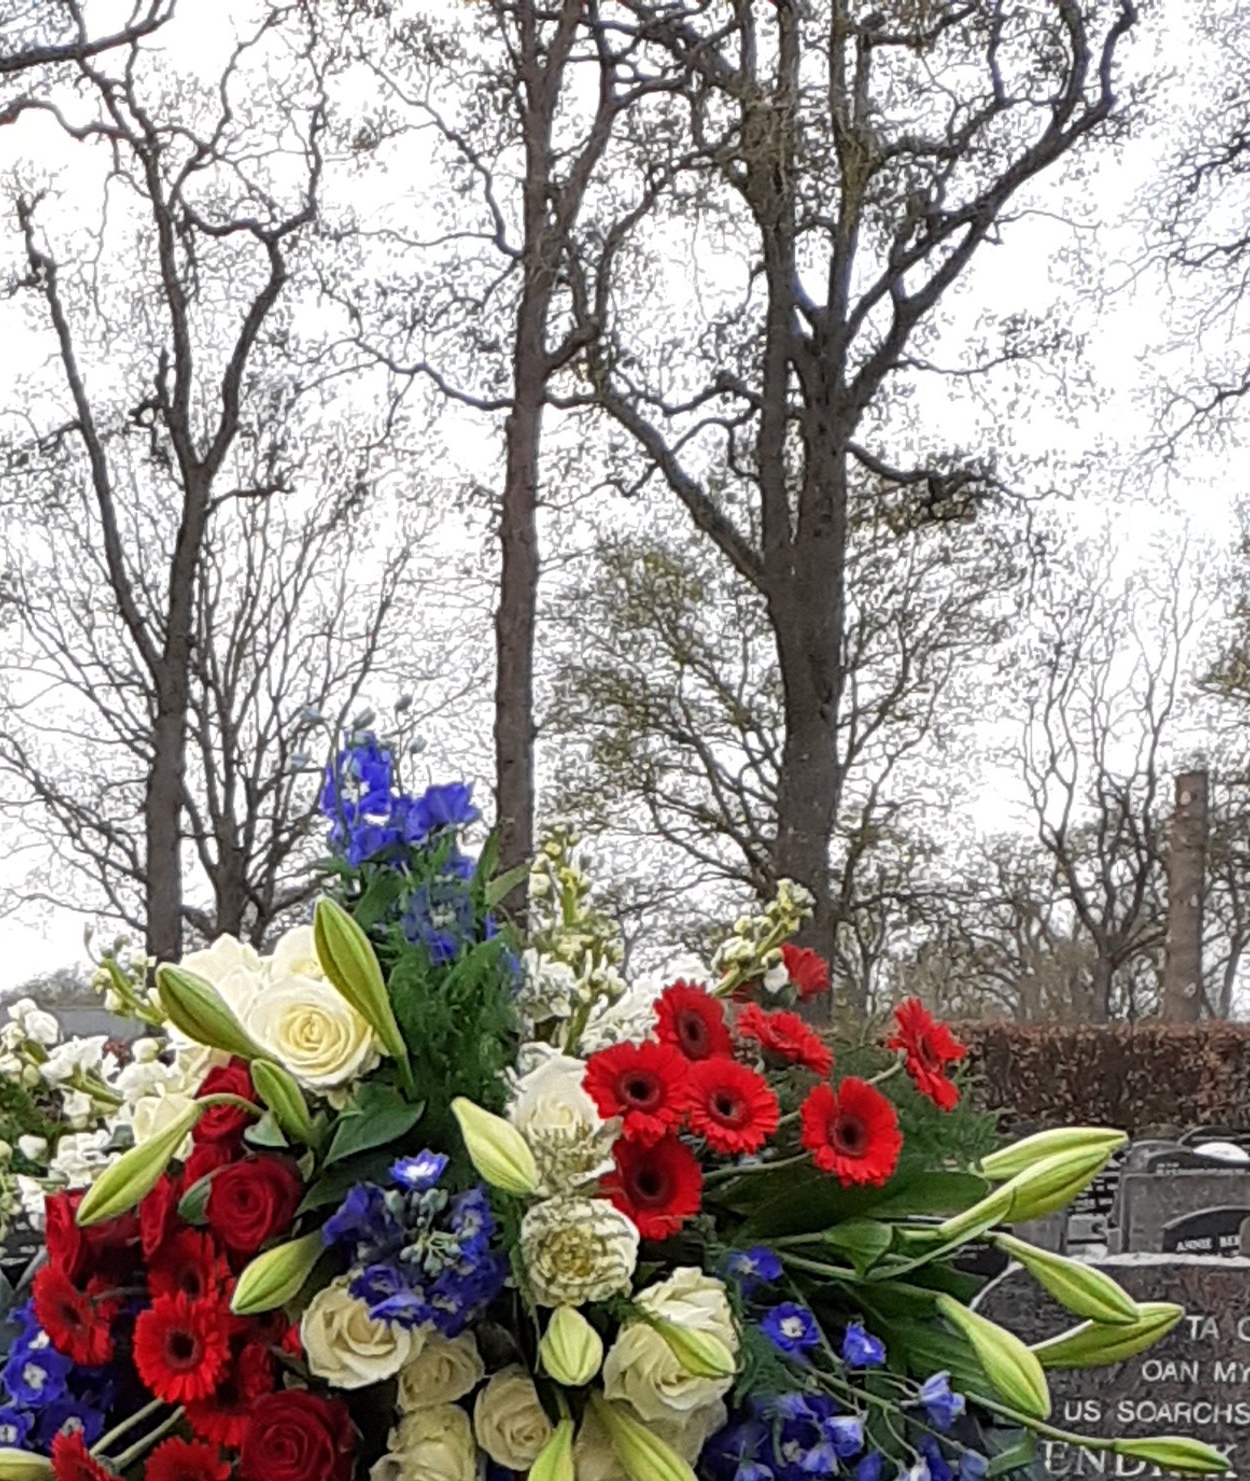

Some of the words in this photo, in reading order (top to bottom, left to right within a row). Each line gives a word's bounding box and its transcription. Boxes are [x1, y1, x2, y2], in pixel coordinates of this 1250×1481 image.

[1186, 1315, 1220, 1340] TA
[1142, 1360, 1199, 1383] OAN
[1064, 1401, 1101, 1422] US
